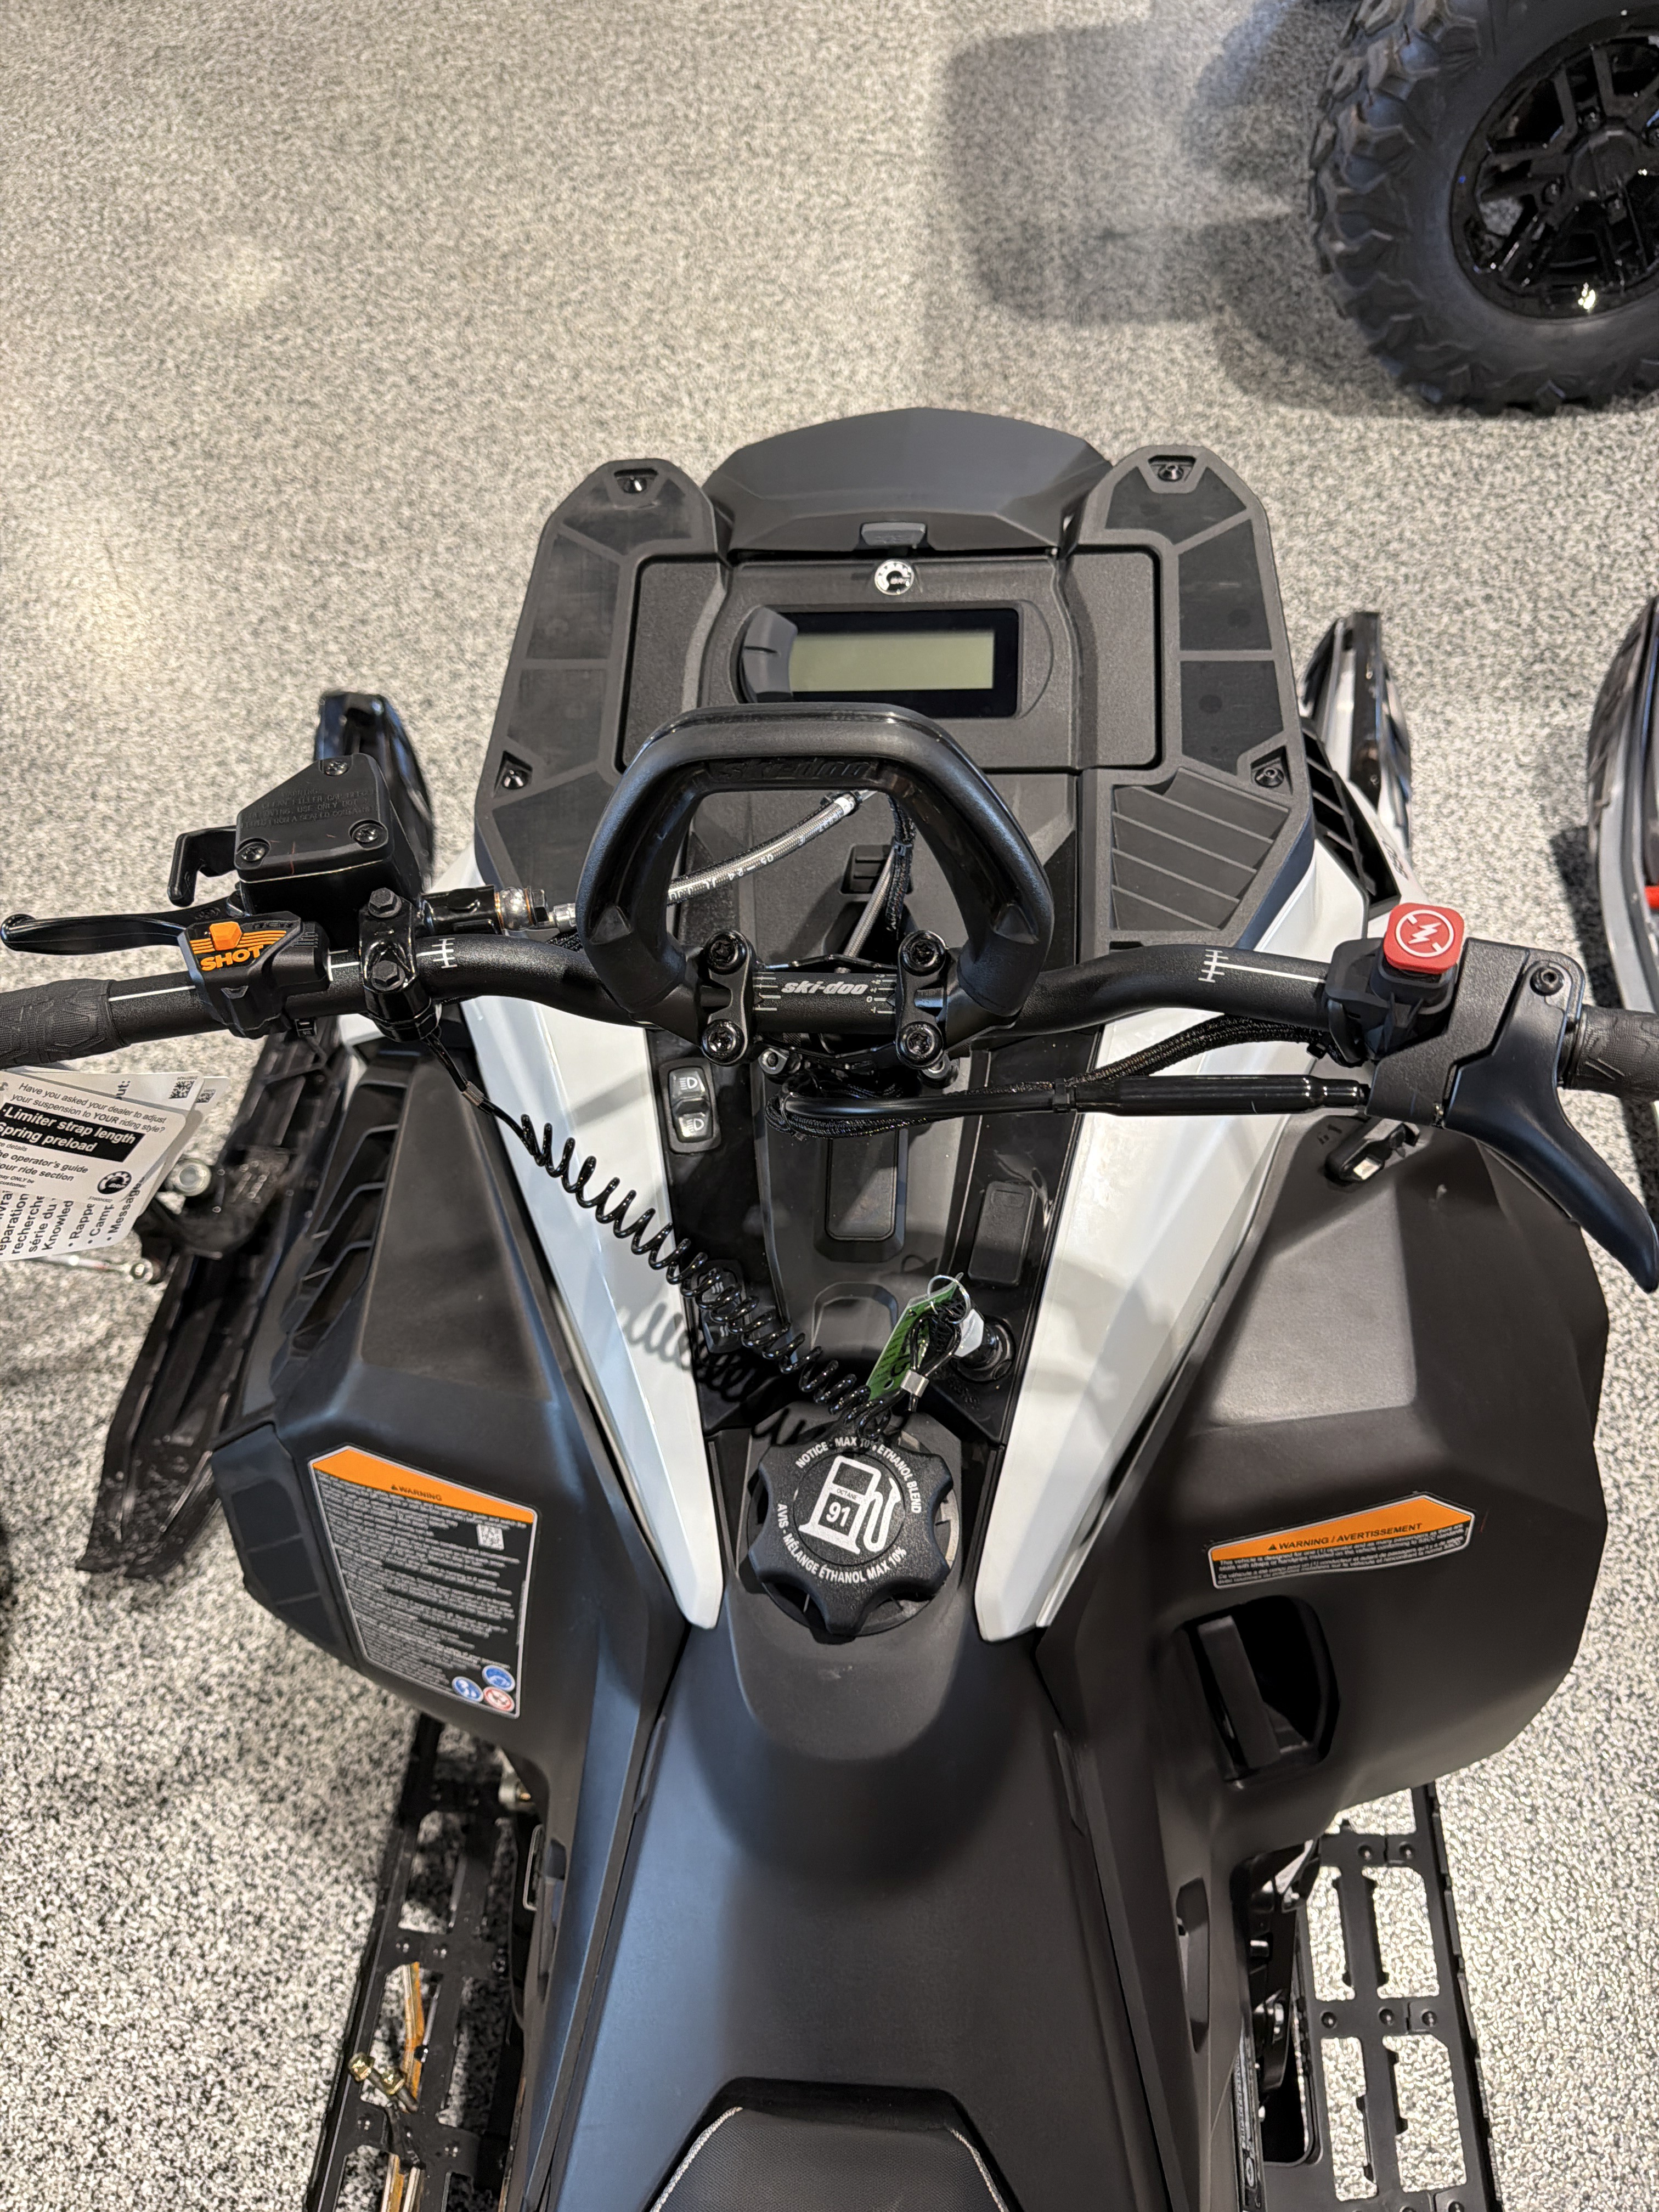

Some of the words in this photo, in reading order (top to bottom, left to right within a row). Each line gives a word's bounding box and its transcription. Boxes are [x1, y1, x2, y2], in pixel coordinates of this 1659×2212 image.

[200, 945, 263, 972] SHOT
[781, 980, 868, 995] ski-doo
[10, 1093, 33, 1105] your
[32, 1098, 83, 1116] suspension
[83, 1110, 92, 1119] to
[93, 1111, 119, 1125] YOUR
[119, 1118, 142, 1130] riding
[142, 1123, 166, 1135] style?
[19, 1082, 43, 1095] Have
[44, 1090, 60, 1099] you
[61, 1093, 88, 1106] asked
[86, 1101, 108, 1111] your
[108, 1105, 134, 1117] dealer
[144, 1113, 167, 1124] adjust
[41, 1135, 98, 1153] preload
[57, 1119, 94, 1137] strap
[93, 1127, 137, 1145] length
[6, 1143, 29, 1152] details
[10, 1154, 61, 1169] operator's
[60, 1164, 89, 1174] guide
[18, 1166, 38, 1176] ride
[39, 1170, 75, 1182] section
[28, 1223, 48, 1253] série
[42, 1204, 58, 1220] du
[41, 1200, 75, 1251] Knowled
[795, 1441, 829, 1469] NOTICE
[834, 1436, 857, 1447] MAX
[877, 1444, 914, 1482] ETHANOL
[906, 1480, 922, 1514] BLEND
[398, 1485, 443, 1502] WARNING
[836, 1487, 858, 1500] OCTANE
[826, 1502, 851, 1527] 91
[777, 1503, 789, 1529] AVIS
[783, 1532, 820, 1575] MÉLANGE
[819, 1564, 867, 1584] ÉTHANOL
[866, 1560, 891, 1581] MAX
[888, 1546, 907, 1566] 10%
[1278, 1537, 1330, 1550] WARNING
[1336, 1522, 1423, 1542] AVERTISSEMENT
